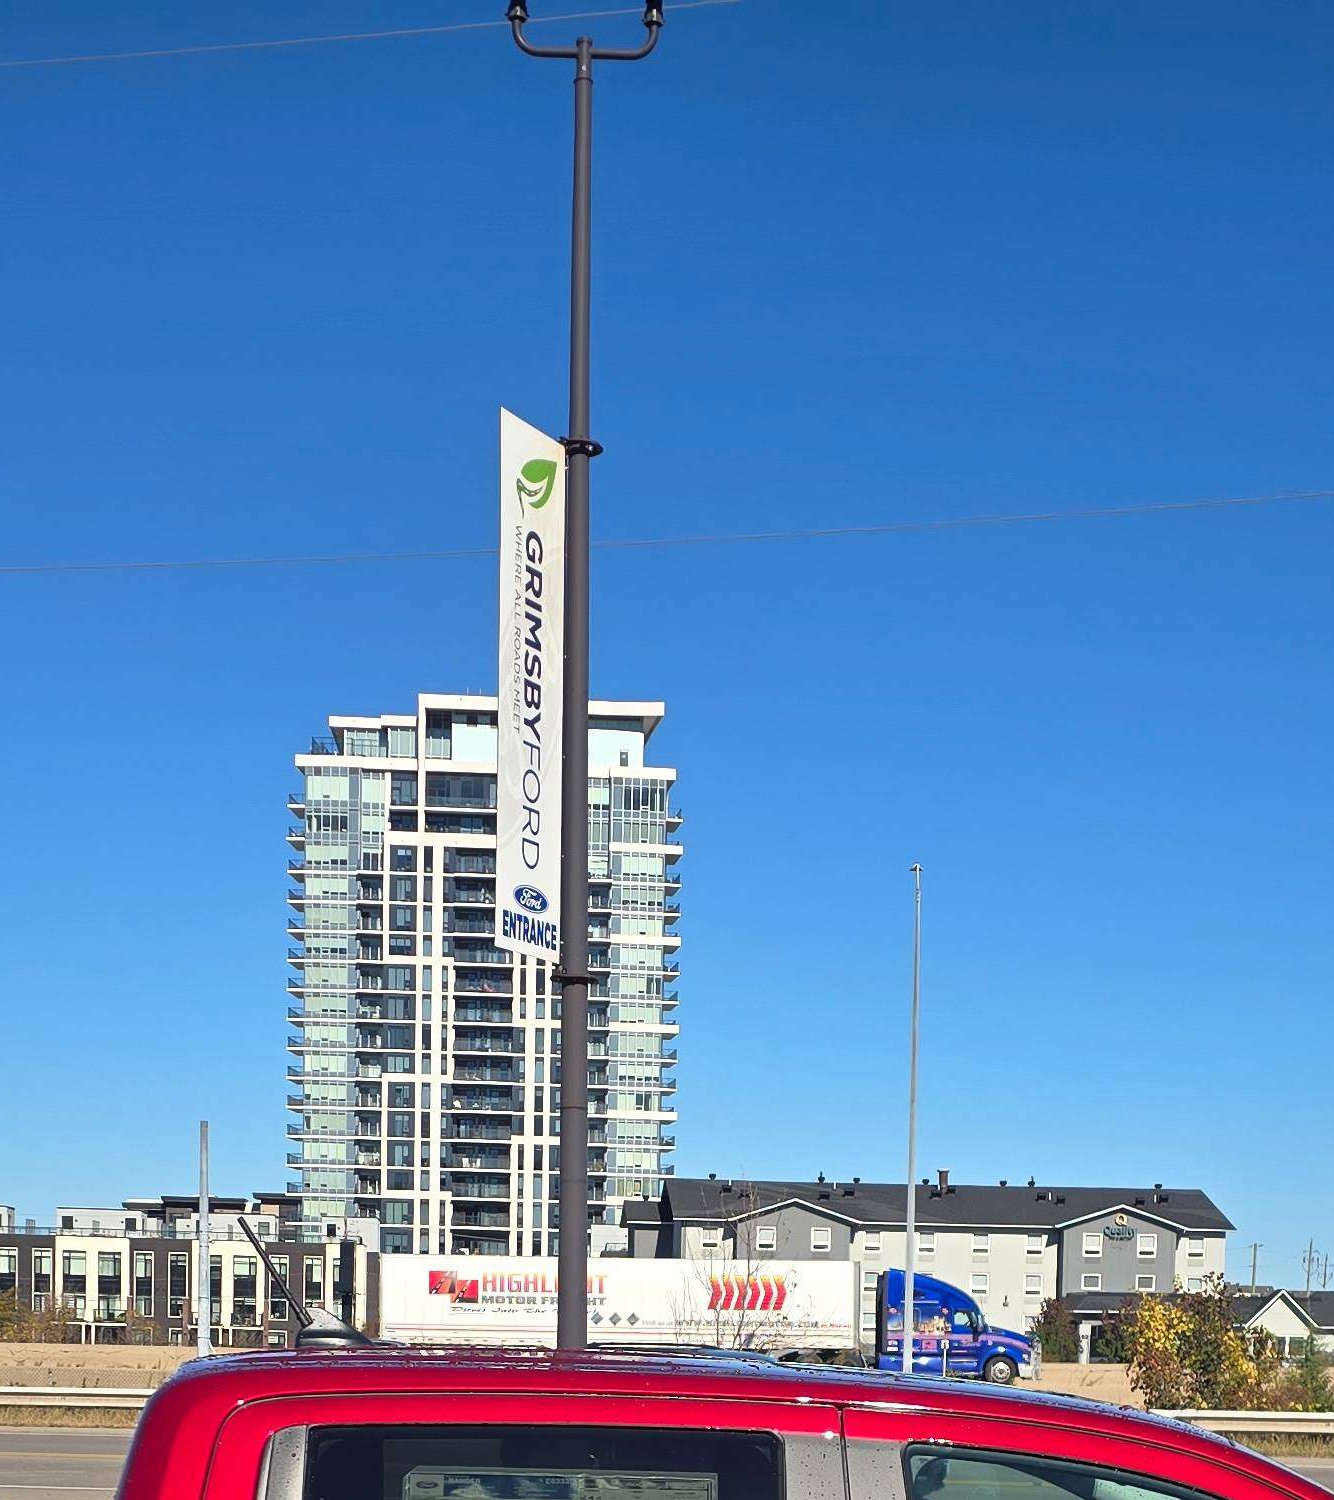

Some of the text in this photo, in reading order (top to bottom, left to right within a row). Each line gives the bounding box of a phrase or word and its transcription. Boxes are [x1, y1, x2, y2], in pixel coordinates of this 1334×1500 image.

[513, 525, 525, 735] WHERE ALL ROADS MEET
[519, 888, 542, 911] Ford
[502, 908, 557, 950] ENTRANCE
[1103, 1226, 1136, 1239] Quality
[481, 1295, 537, 1305] MOTOR
